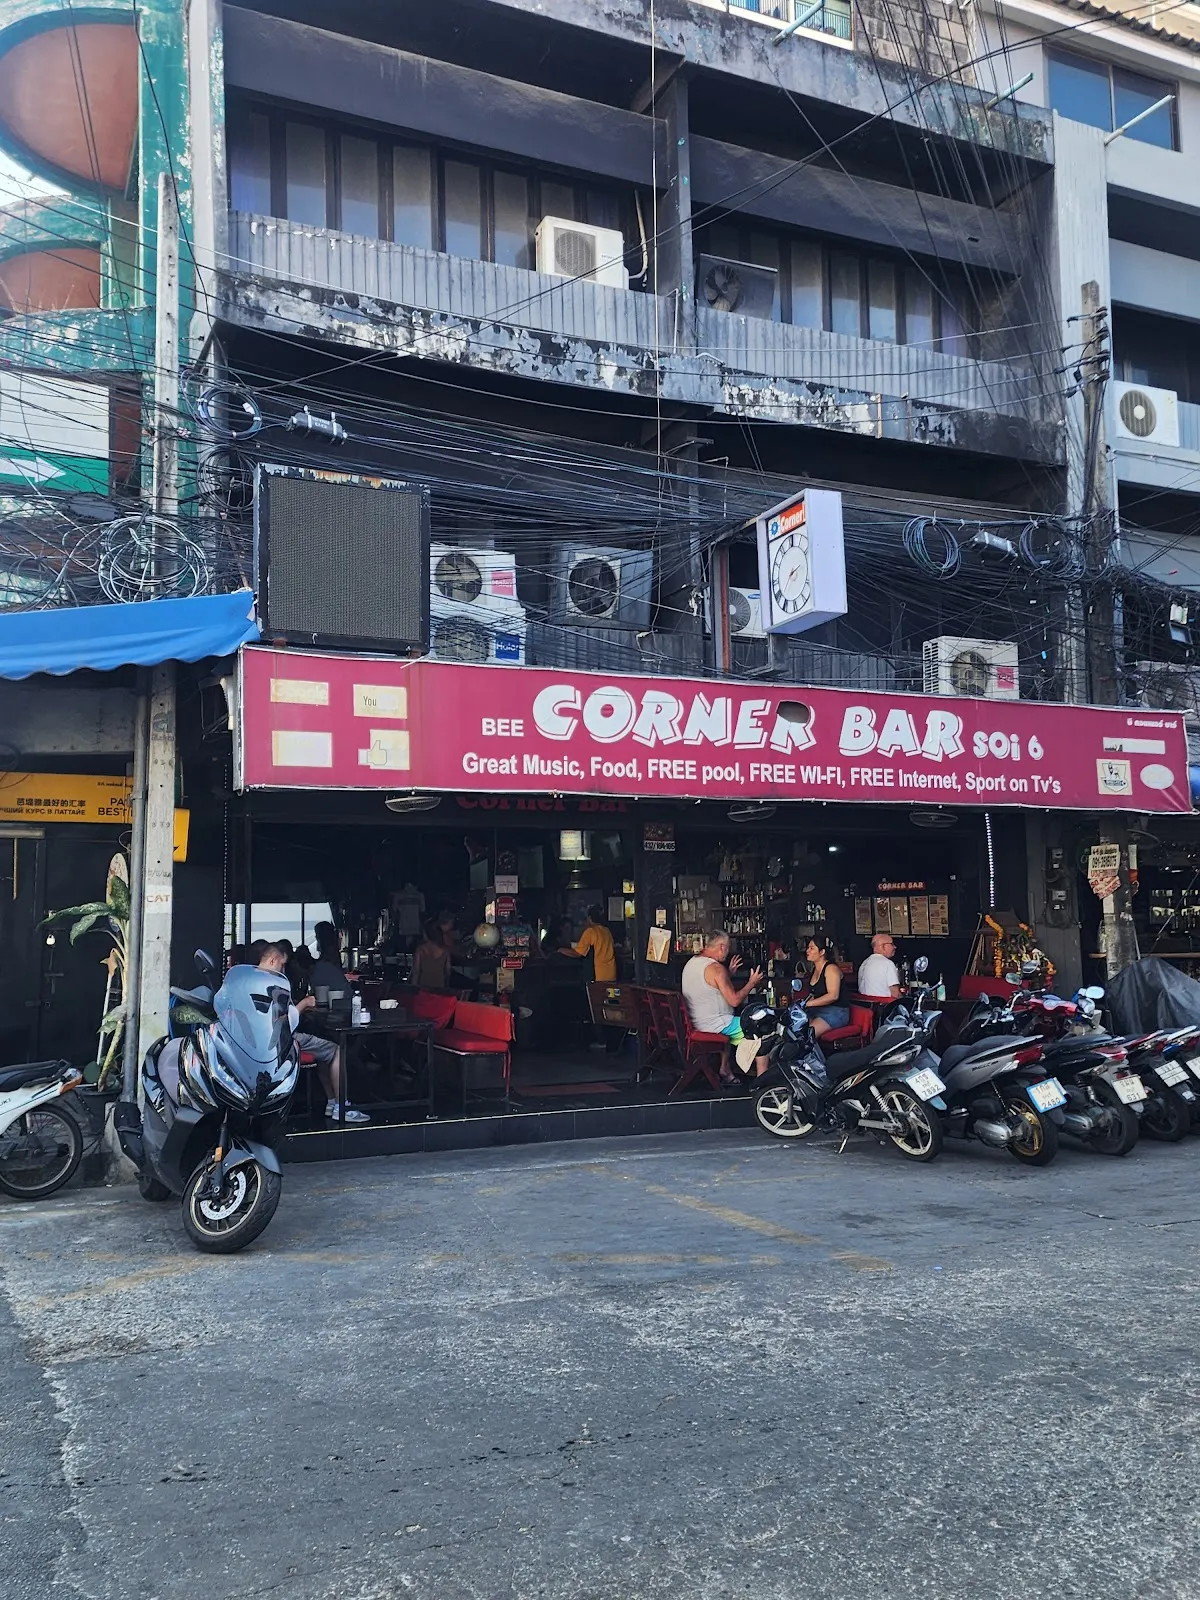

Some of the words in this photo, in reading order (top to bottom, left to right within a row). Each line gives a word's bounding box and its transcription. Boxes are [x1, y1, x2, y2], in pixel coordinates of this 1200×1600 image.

[363, 695, 377, 706] You
[481, 717, 524, 737] BEE
[532, 684, 817, 755] CORNER
[838, 705, 965, 763] BAR
[1028, 734, 1044, 761] 6
[462, 751, 518, 775] Great
[523, 753, 585, 780] Music,
[590, 756, 642, 782] Food,
[647, 758, 697, 780] FREE
[702, 761, 745, 785] pool,
[749, 762, 796, 784] FREE
[850, 767, 894, 787] FREE
[899, 768, 962, 793] Internet,
[965, 771, 1006, 794] Sport
[1010, 778, 1028, 792] on
[908, 881, 924, 889] BAR
[146, 894, 171, 903] CAT
[922, 1085, 941, 1098] 7892
[1126, 1092, 1141, 1102] 631
[1041, 1097, 1061, 1109] 2480
